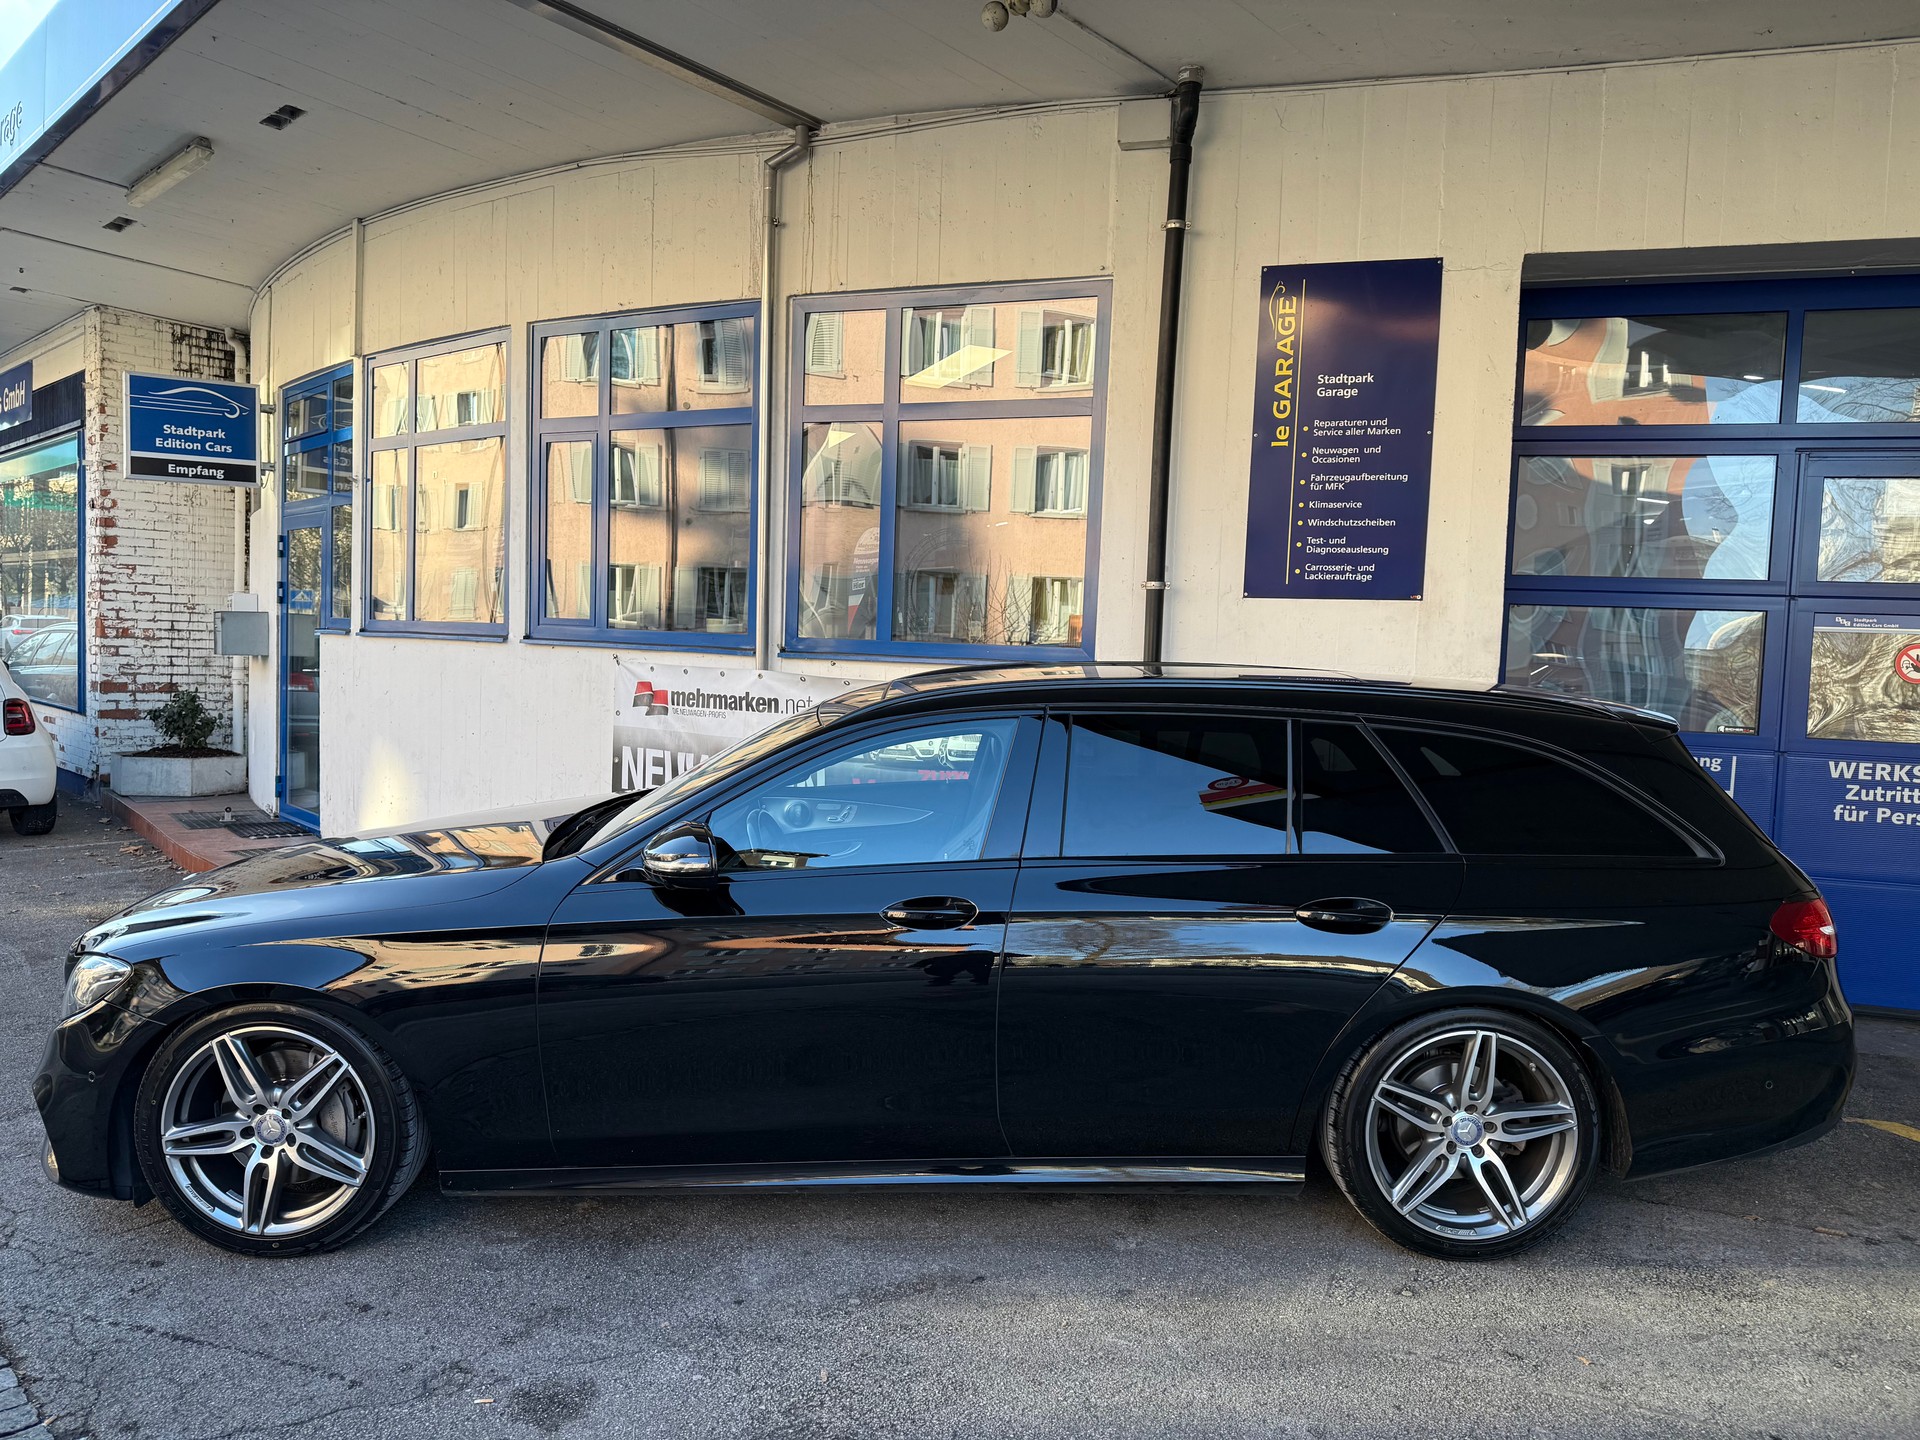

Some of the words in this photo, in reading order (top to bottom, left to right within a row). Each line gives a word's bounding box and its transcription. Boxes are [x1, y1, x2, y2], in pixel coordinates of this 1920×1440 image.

[1272, 296, 1297, 420] GARAGE
[1317, 372, 1374, 386] Stadtpark
[3, 380, 26, 412] GmbH
[1316, 387, 1358, 399] Garage
[1314, 419, 1368, 429] Reparaturen
[1370, 418, 1388, 426] und
[163, 424, 226, 439] Stadtpark
[1271, 425, 1290, 447] le
[1313, 427, 1344, 437] Service
[1345, 427, 1365, 436] aller
[1367, 426, 1401, 436] Marken
[155, 437, 201, 451] Edition
[205, 441, 232, 453] Cars
[1312, 446, 1359, 456] Neuwagen
[1364, 445, 1381, 454] und
[1311, 455, 1361, 464] Occasionen
[168, 463, 225, 480] Empfang
[1310, 472, 1408, 483] Fahrzeugaufbereitung
[1310, 482, 1323, 491] für
[1325, 482, 1345, 490] MFK
[1308, 500, 1363, 509] Klimaservice
[1307, 518, 1396, 527] Windschutzscheiben
[1306, 536, 1327, 545] Test-
[1328, 536, 1346, 545] und
[1306, 545, 1389, 556] Diagnoseauslesung
[1305, 563, 1355, 572] Carrosserie-
[1357, 563, 1375, 572] und
[1304, 572, 1373, 583] Lackieraufträge
[671, 688, 813, 715] mehrmarken.net
[1845, 784, 1920, 805] Zutritt
[1833, 804, 1868, 822] für
